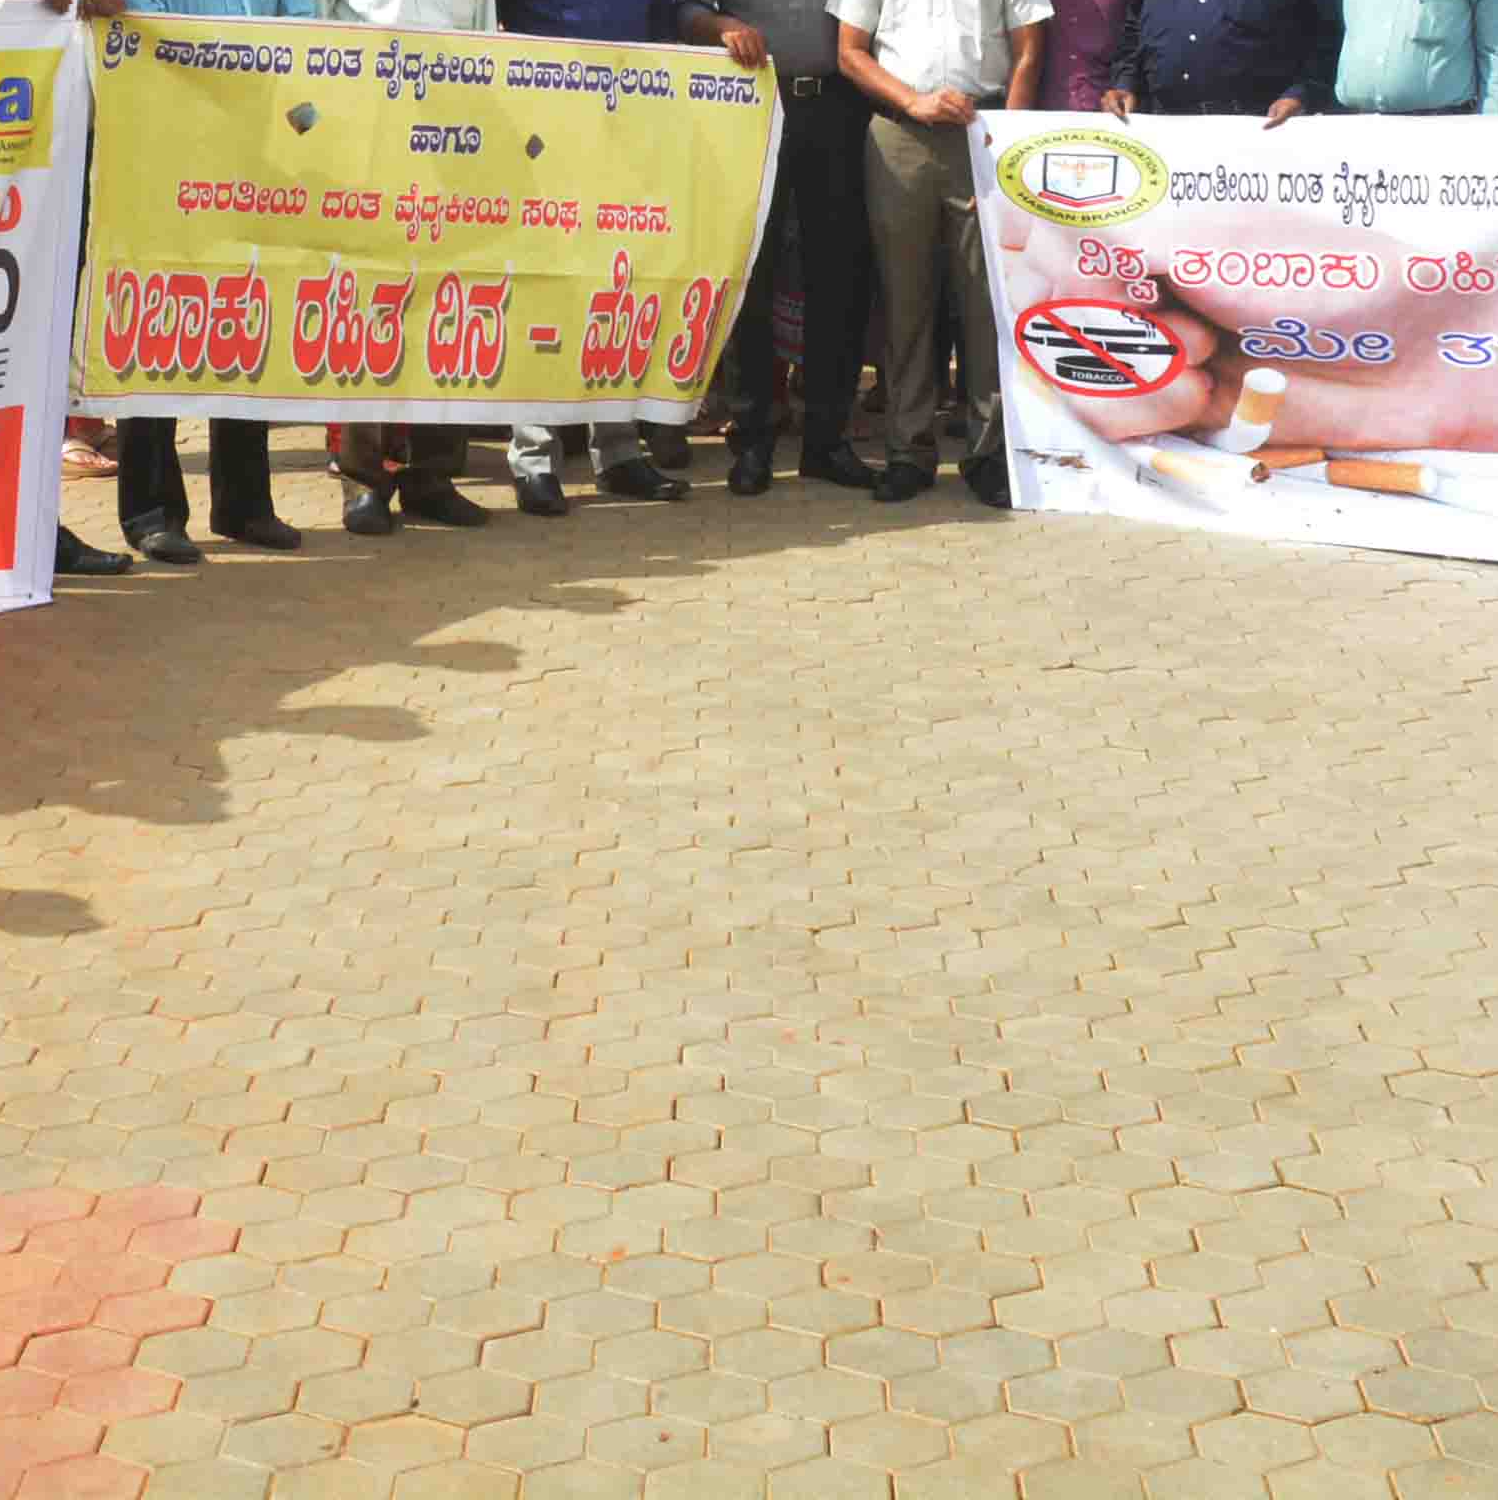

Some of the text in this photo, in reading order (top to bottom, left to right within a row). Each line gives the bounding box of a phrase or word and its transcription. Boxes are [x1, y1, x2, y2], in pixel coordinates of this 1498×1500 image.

[101, 19, 141, 69] ಶ್ರೀ
[154, 37, 294, 75] ಹಾಸನಾಂಬ
[306, 45, 363, 78] ದಂತ
[374, 47, 495, 101] ವೈದ್ಯಕೀಯ
[408, 124, 482, 155] ಹಾಗೂ
[176, 178, 309, 217] ಭಾರತೀಯ
[320, 189, 380, 221] ದಂತ
[393, 180, 510, 245] ವೈದ್ಯಕೀಯ
[1170, 164, 1269, 206] ಭಾರತೀಯ
[1277, 171, 1324, 205] ದಂತ
[1332, 161, 1430, 227] ವೈದ್ಯಕೀಯ
[1076, 237, 1158, 302] ವಿಶ್ವ
[1173, 249, 1380, 291] ತಂಬಾಕು
[291, 257, 418, 378] ರಹಿತ
[425, 262, 512, 381] ದಿನ
[581, 249, 661, 381] ಮೇ
[1241, 317, 1395, 363] ಮೇ
[1071, 370, 1126, 383] TOBACCO
